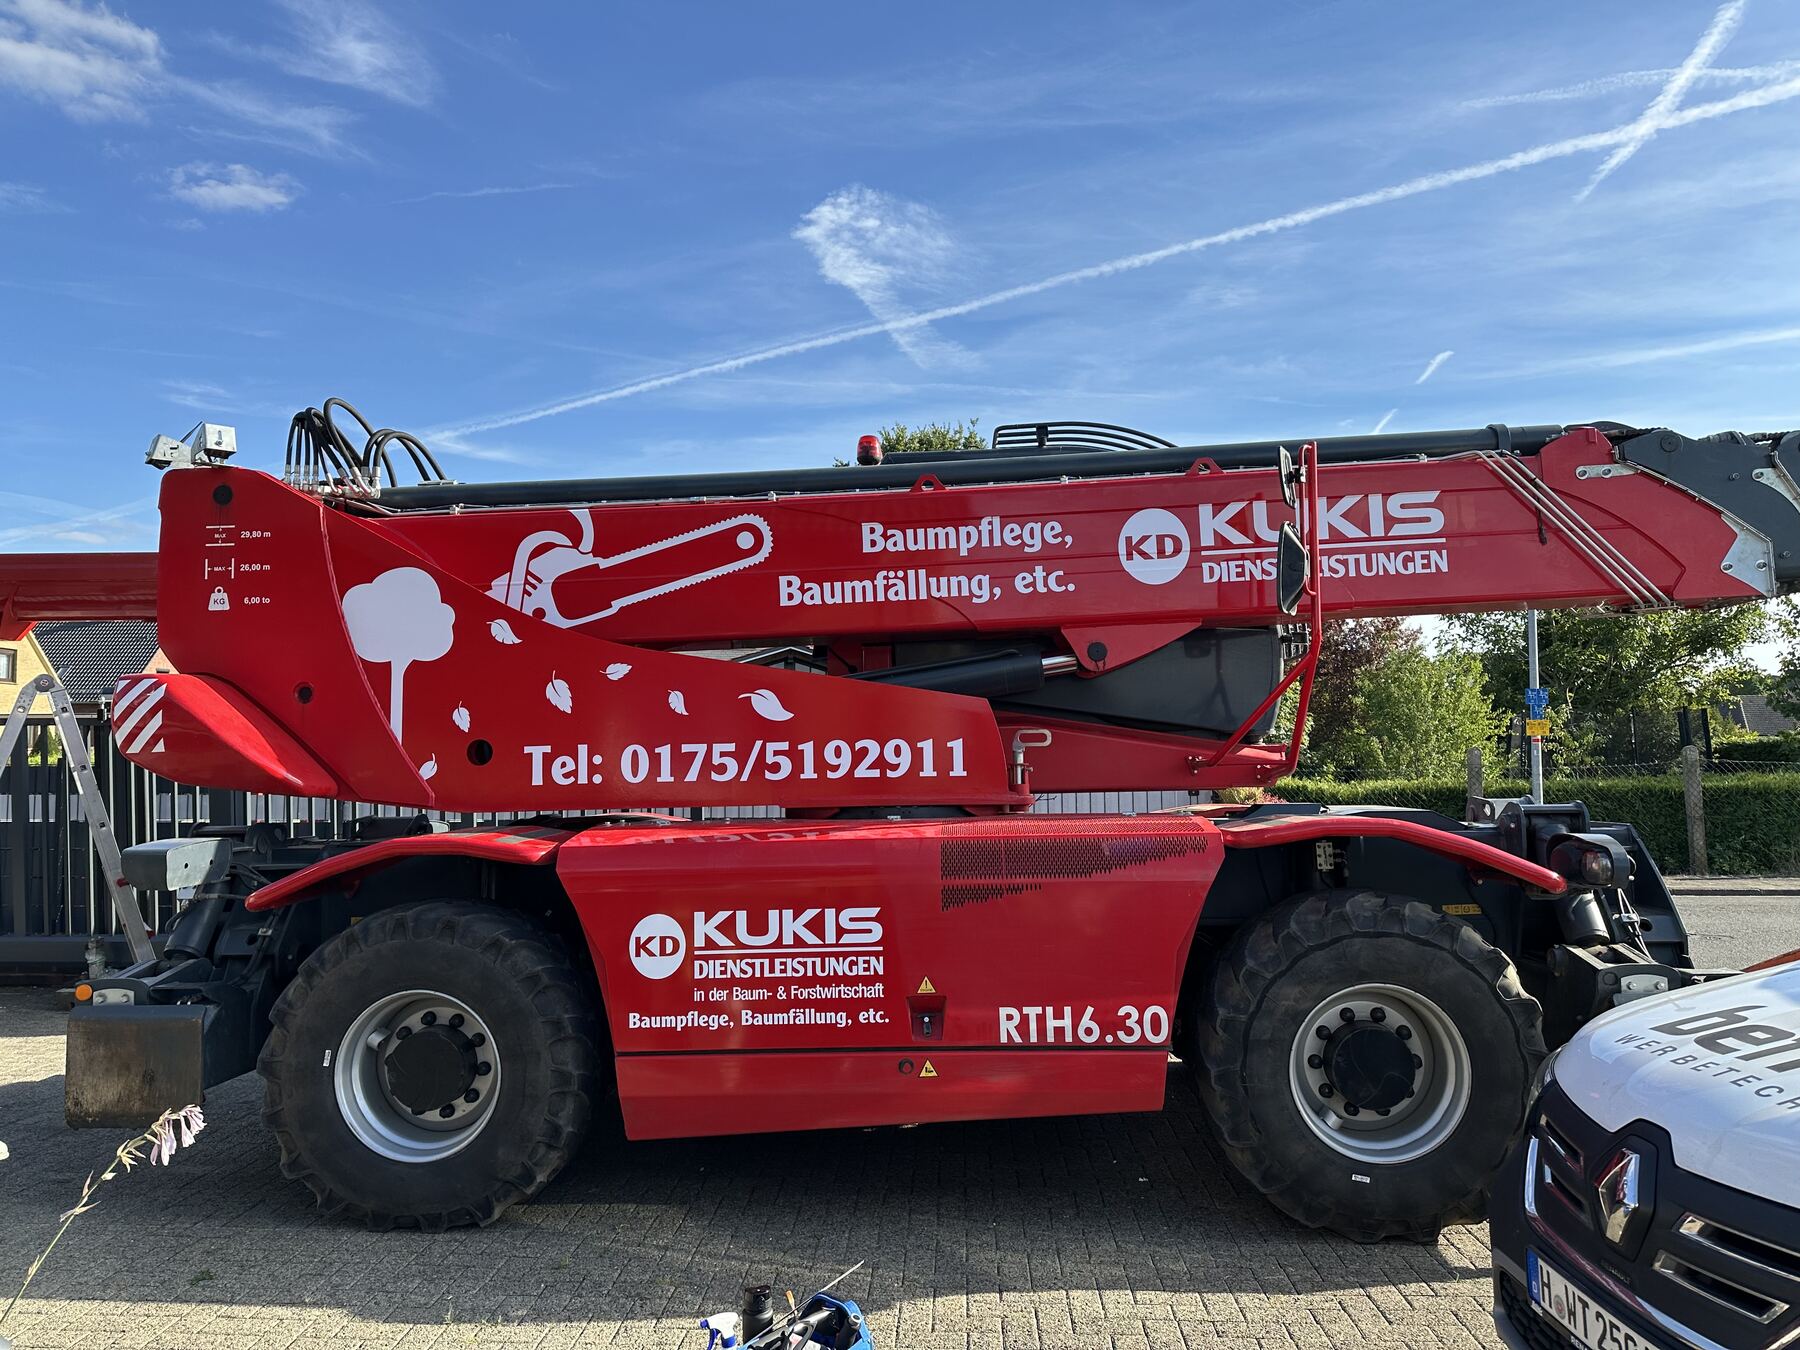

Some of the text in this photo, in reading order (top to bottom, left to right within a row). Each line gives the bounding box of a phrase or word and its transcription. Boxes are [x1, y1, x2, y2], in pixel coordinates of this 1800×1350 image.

[1199, 490, 1445, 546] KUKIS
[240, 530, 262, 539] 29,80
[861, 515, 1073, 556] Baumpflege,
[1124, 533, 1184, 562] KD
[239, 563, 261, 572] 26,00
[1201, 550, 1448, 584] DIENSISTUNGEN
[243, 596, 271, 605] 6,00 to
[778, 565, 1076, 607] Baumfällung, etc.
[523, 738, 968, 786] Tel: 0175/5192911
[693, 907, 883, 948] KUKIS
[633, 935, 681, 958] KD
[693, 956, 884, 980] DIENSTLEISTUNGEN
[694, 982, 884, 1002] in der Baum- & Forstwirtschaft
[628, 1008, 890, 1032] Baumpflege, Baumfällung, etc.
[999, 1005, 1169, 1044] RTH6.30
[1539, 1265, 1553, 1309] H
